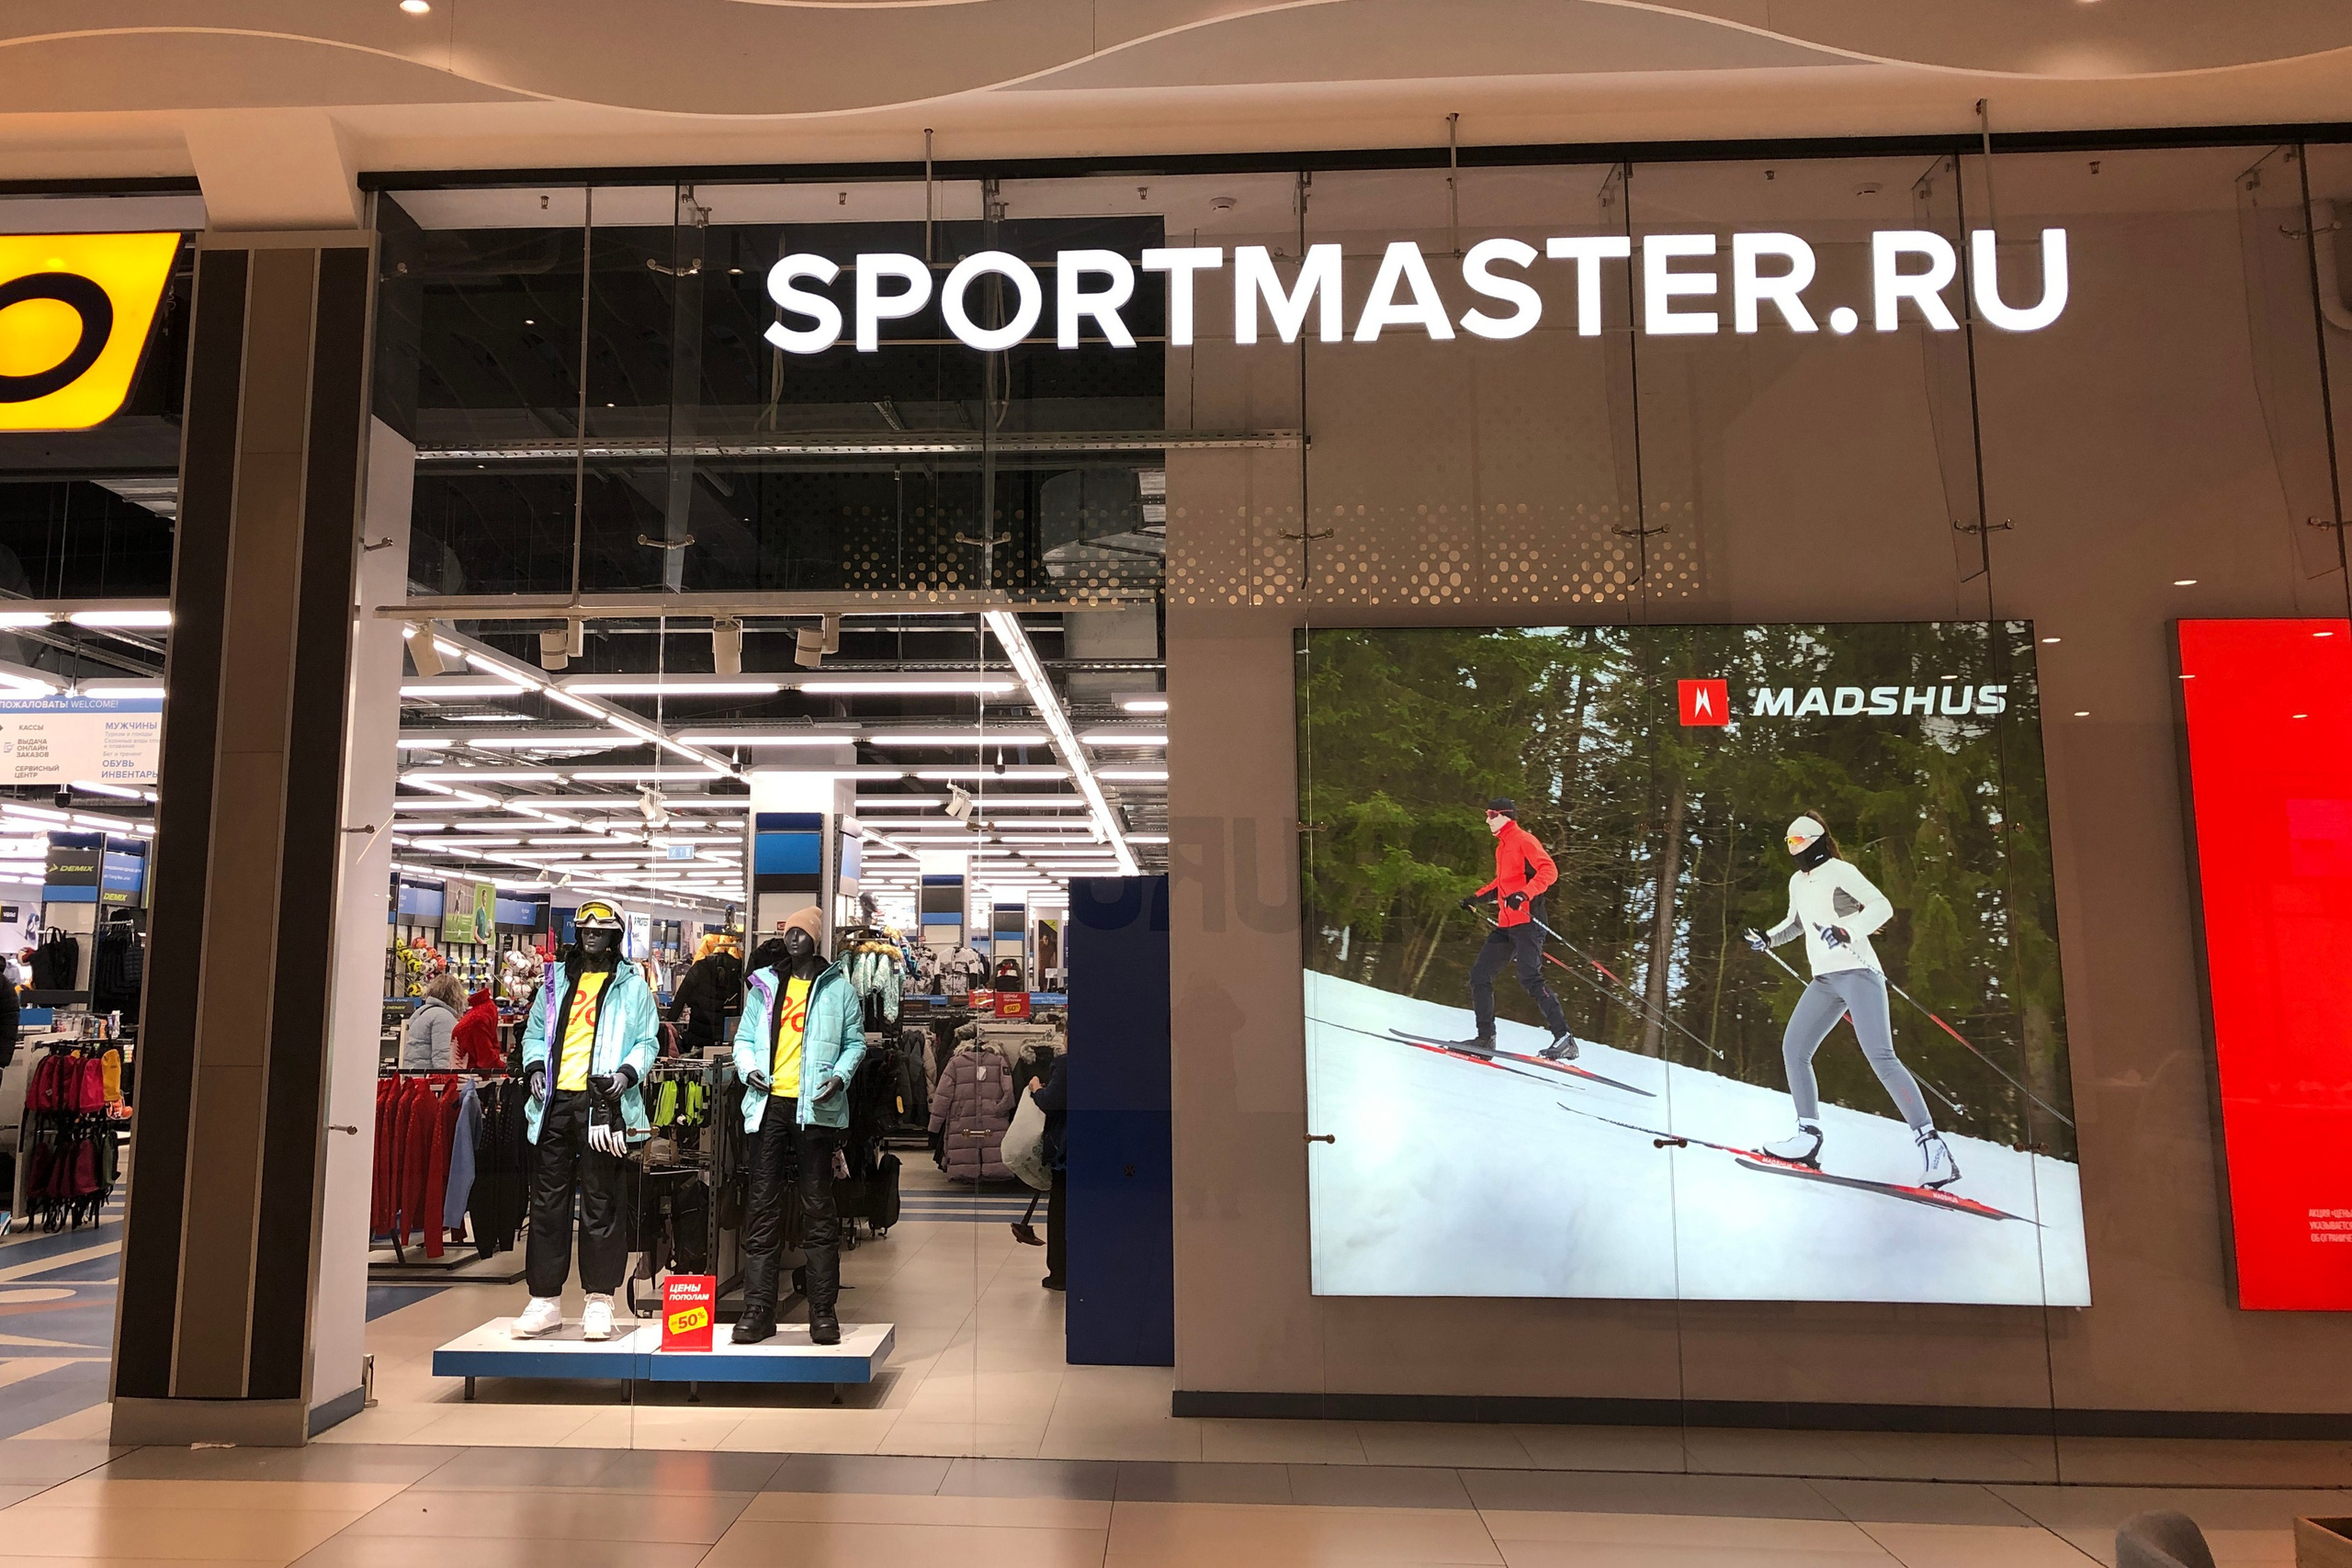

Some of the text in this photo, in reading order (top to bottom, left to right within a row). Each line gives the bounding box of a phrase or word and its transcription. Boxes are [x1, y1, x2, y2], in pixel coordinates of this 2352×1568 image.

[764, 228, 2070, 354] SPORTMASTER.RU
[71, 699, 119, 708] WELCOME!
[1752, 684, 2008, 716] MADSHUS
[102, 760, 135, 768] ОБУВЬ
[101, 770, 158, 778] ИНВЕНТАРЬ
[103, 892, 128, 901] DEMIX
[670, 1283, 701, 1293] ЦЕНЫ
